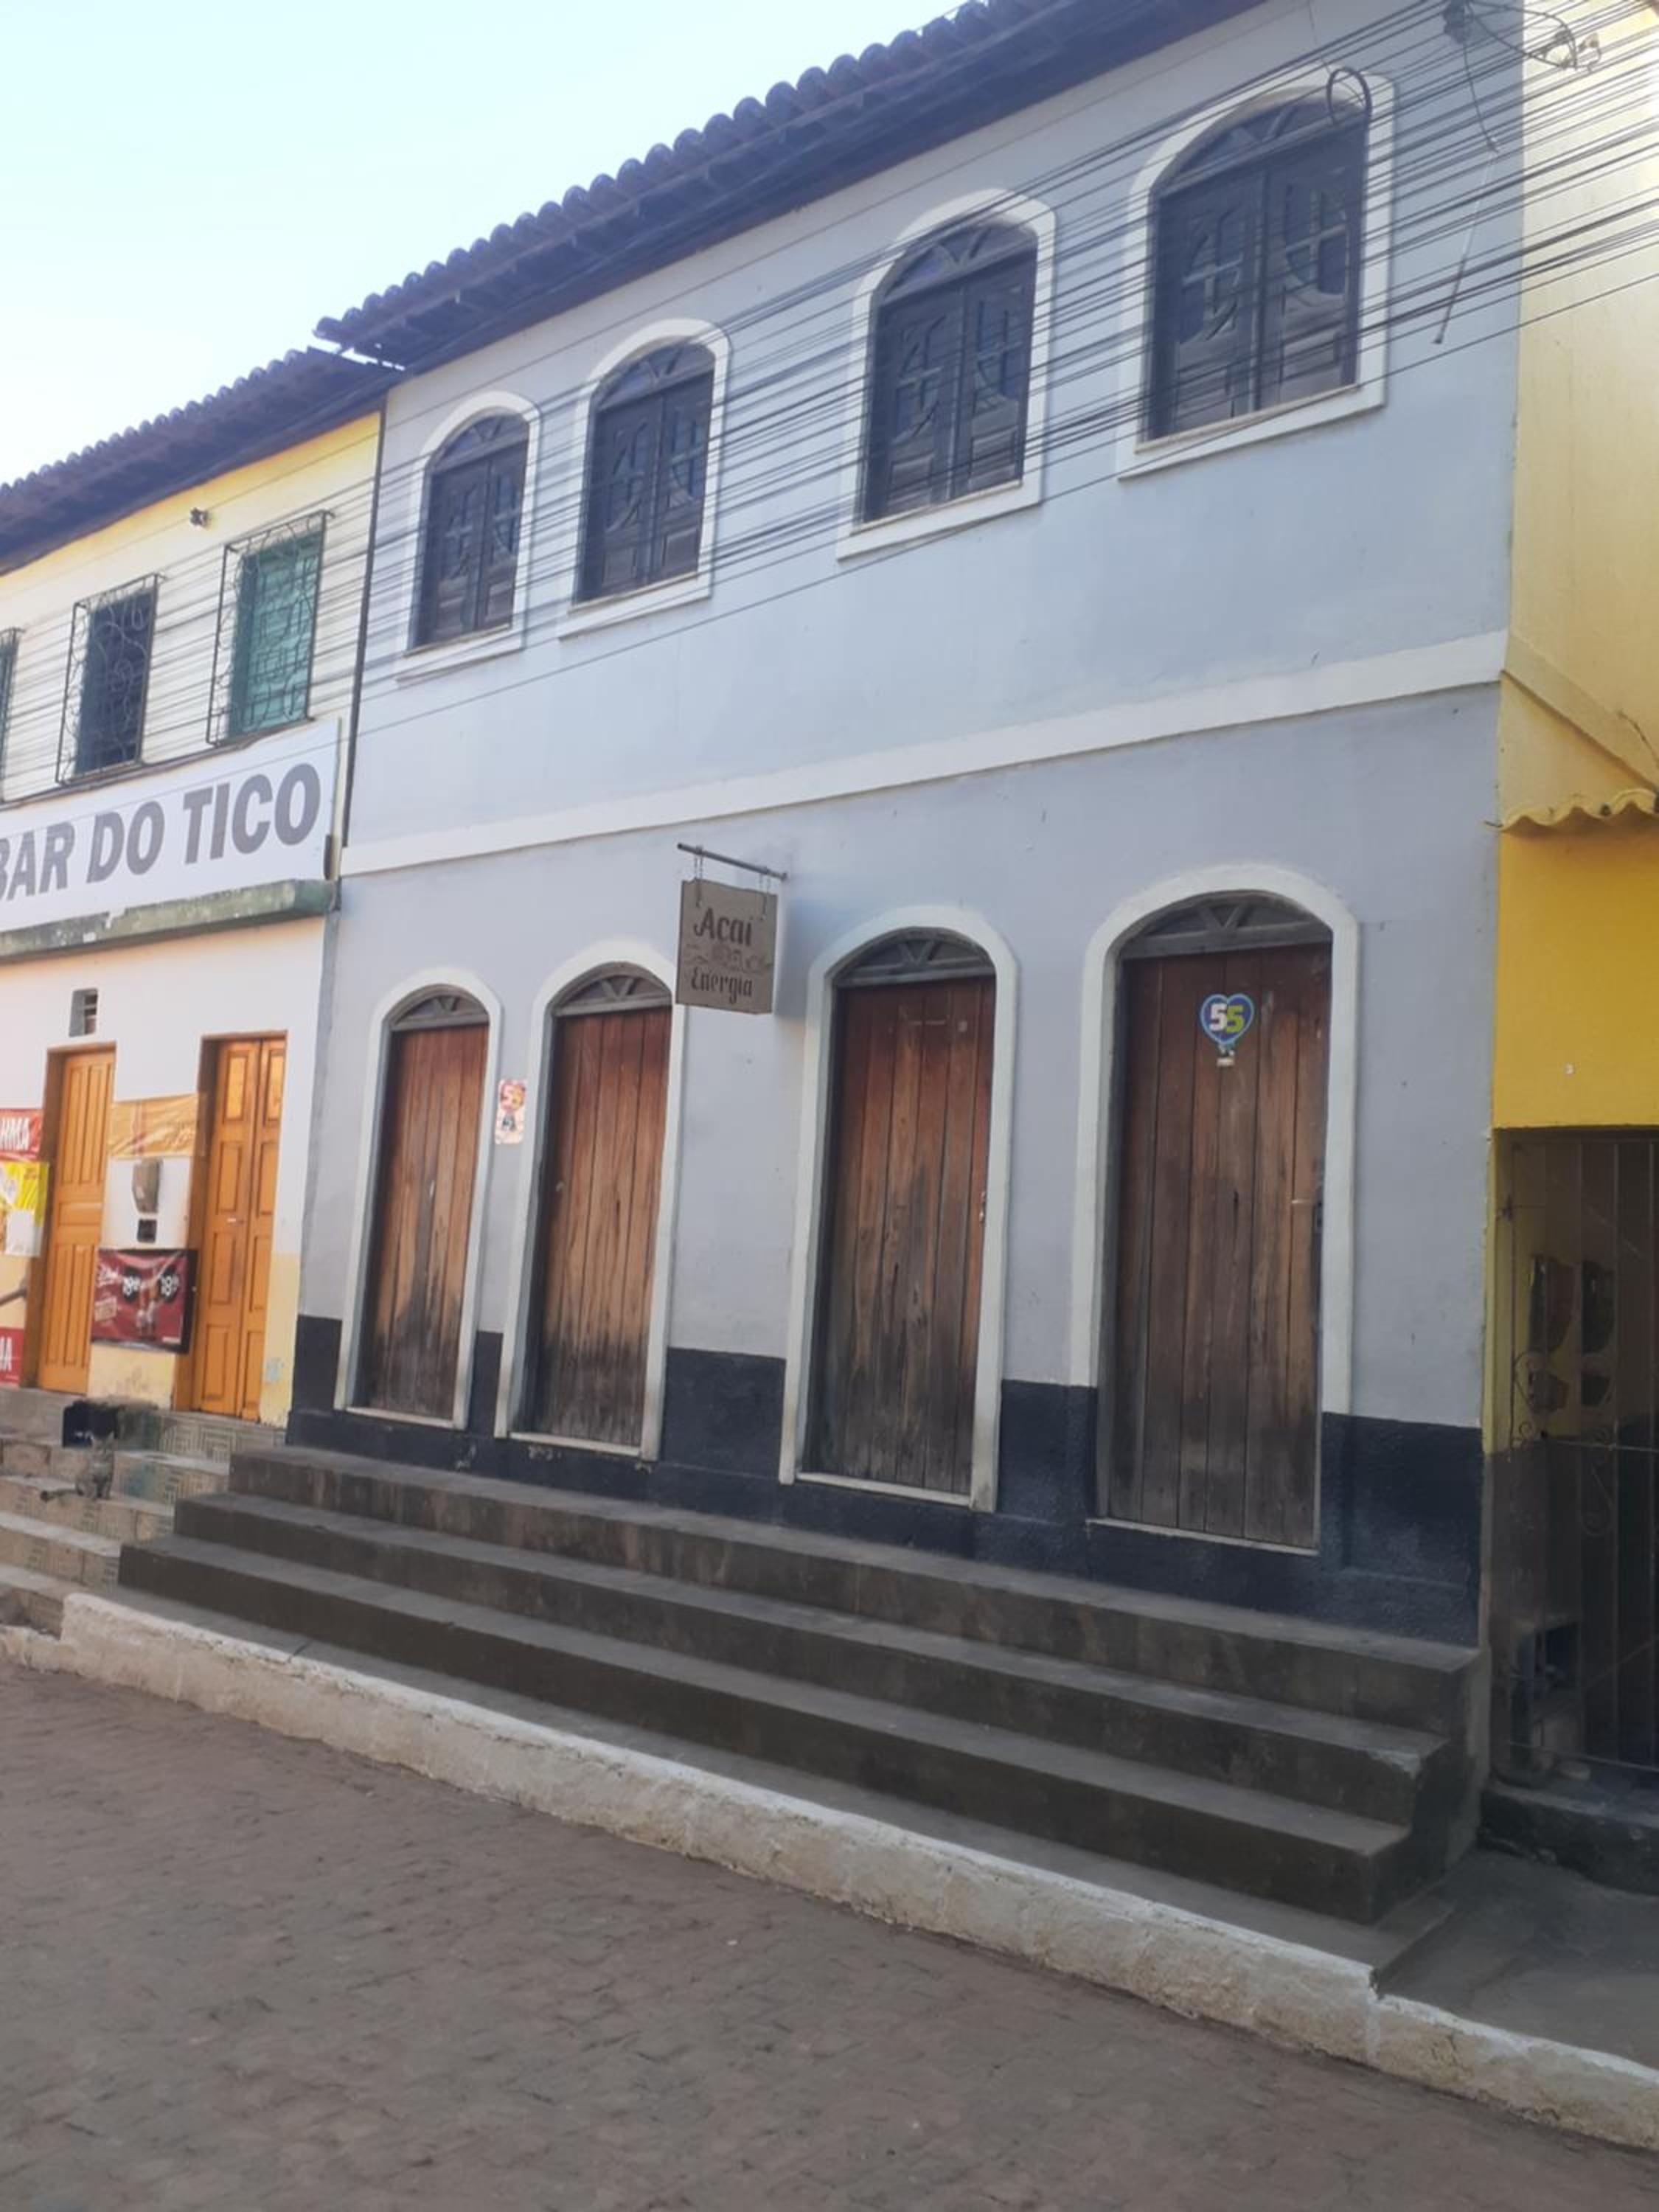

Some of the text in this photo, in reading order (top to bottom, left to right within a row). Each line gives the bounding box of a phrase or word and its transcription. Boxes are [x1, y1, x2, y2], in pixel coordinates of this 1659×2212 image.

[86, 801, 165, 883] DO
[183, 763, 321, 864] TICO
[1209, 1003, 1245, 1033] 55
